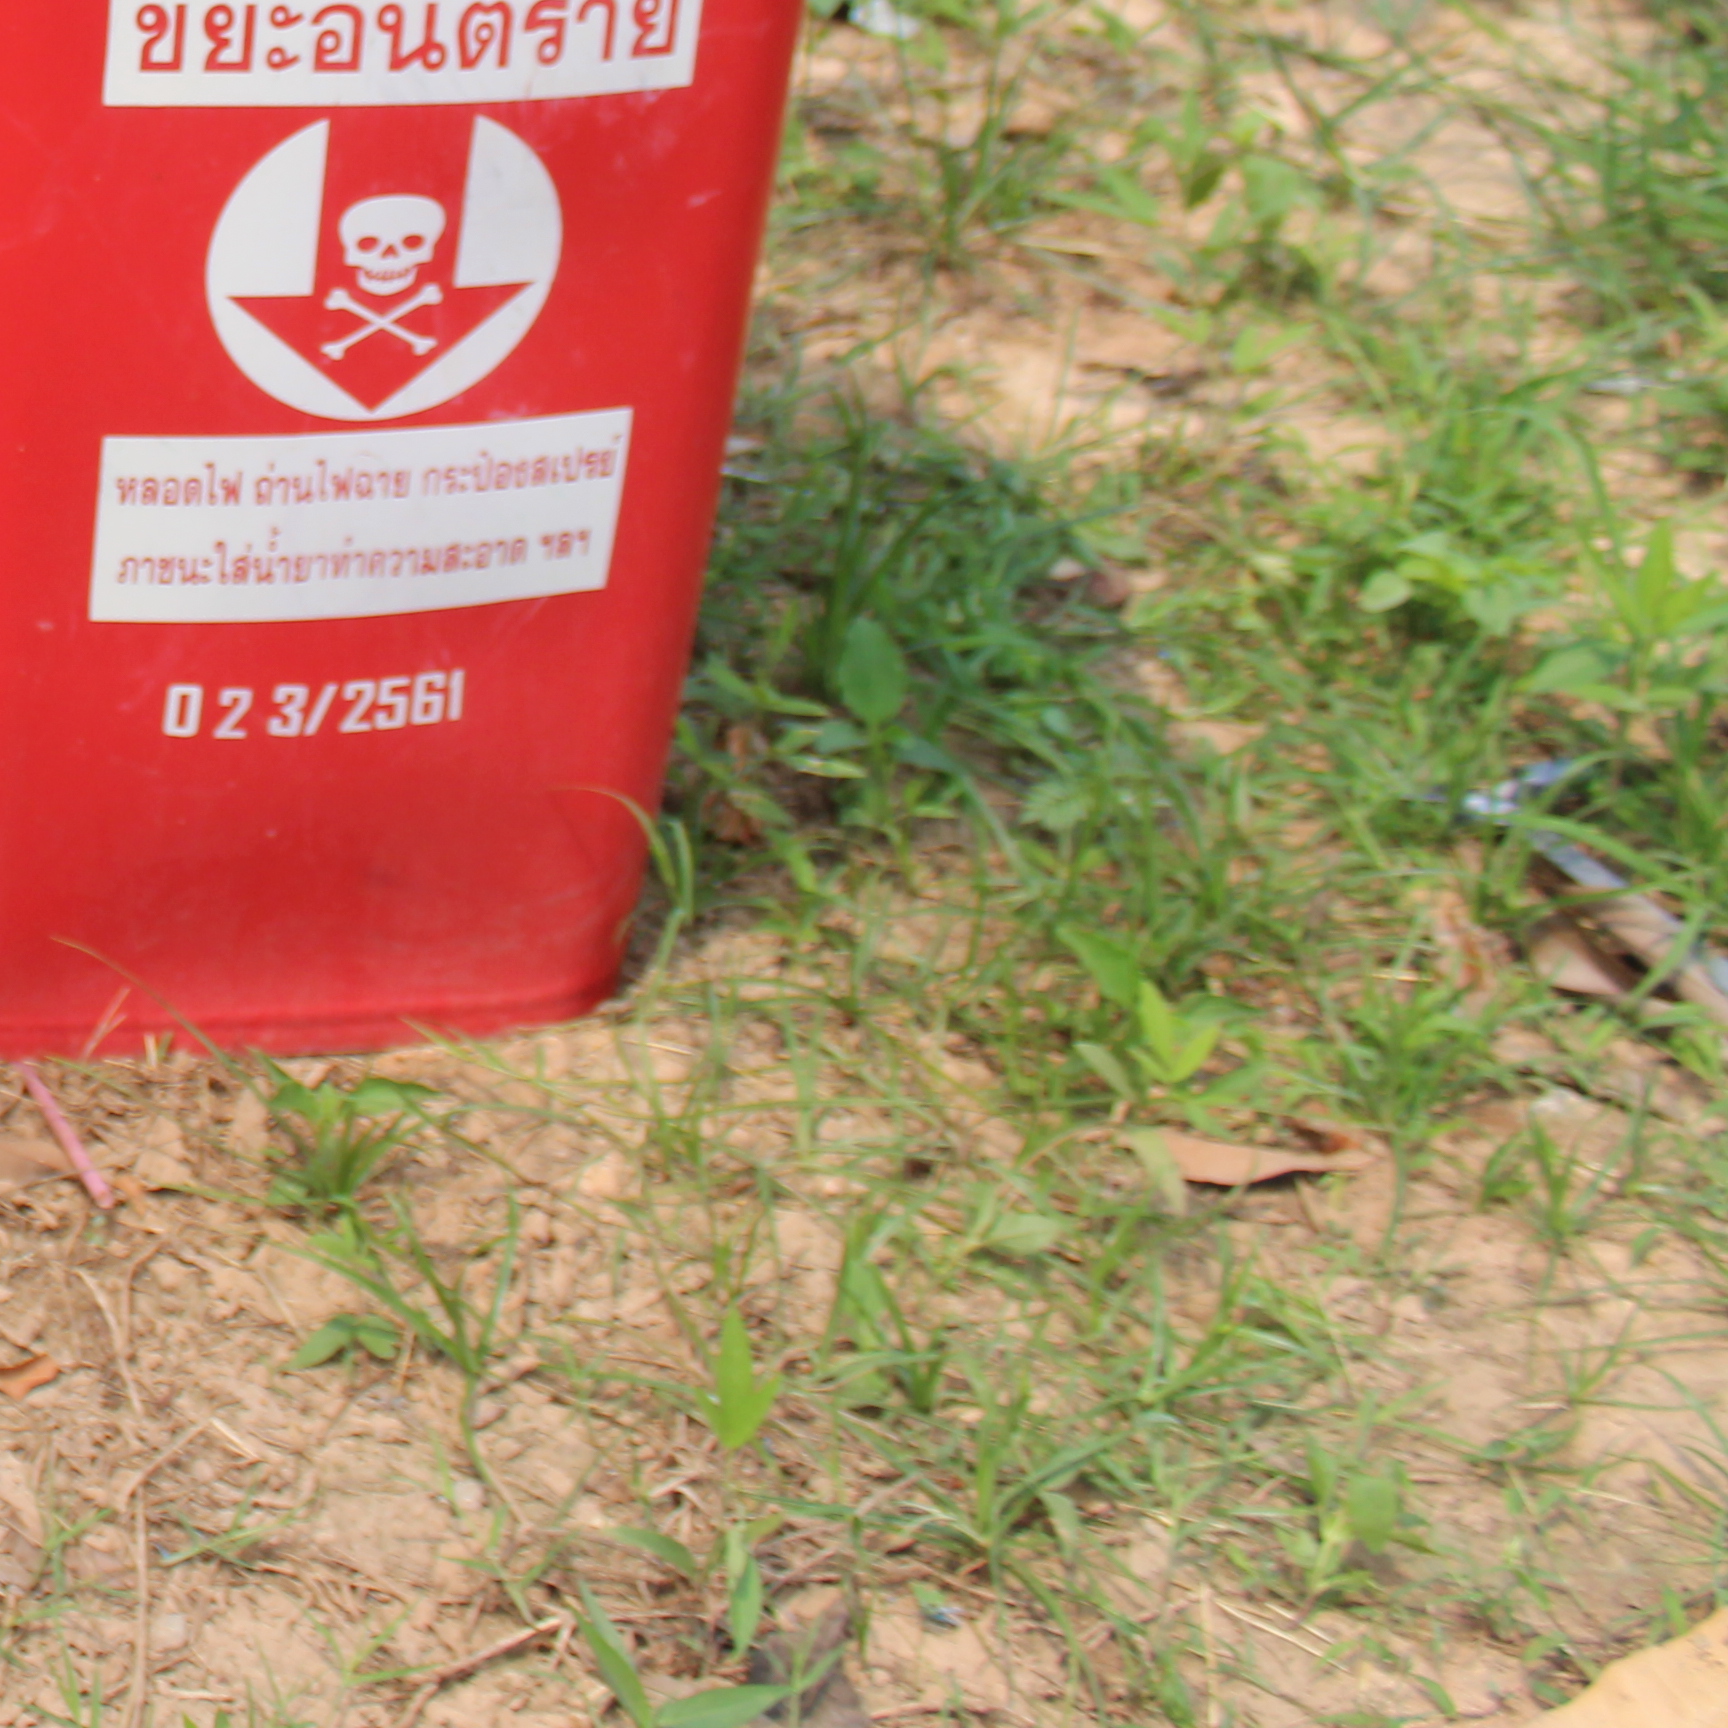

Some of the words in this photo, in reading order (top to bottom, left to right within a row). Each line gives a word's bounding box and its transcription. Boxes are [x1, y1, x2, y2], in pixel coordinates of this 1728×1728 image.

[115, 459, 245, 506] หลอดไฟ
[254, 456, 411, 507] ถ่านไฟฉาย
[421, 432, 622, 496] กระป๋องสเปรย์
[115, 525, 529, 585] ภาชนะใส่น้ำยาทำความสะอาด
